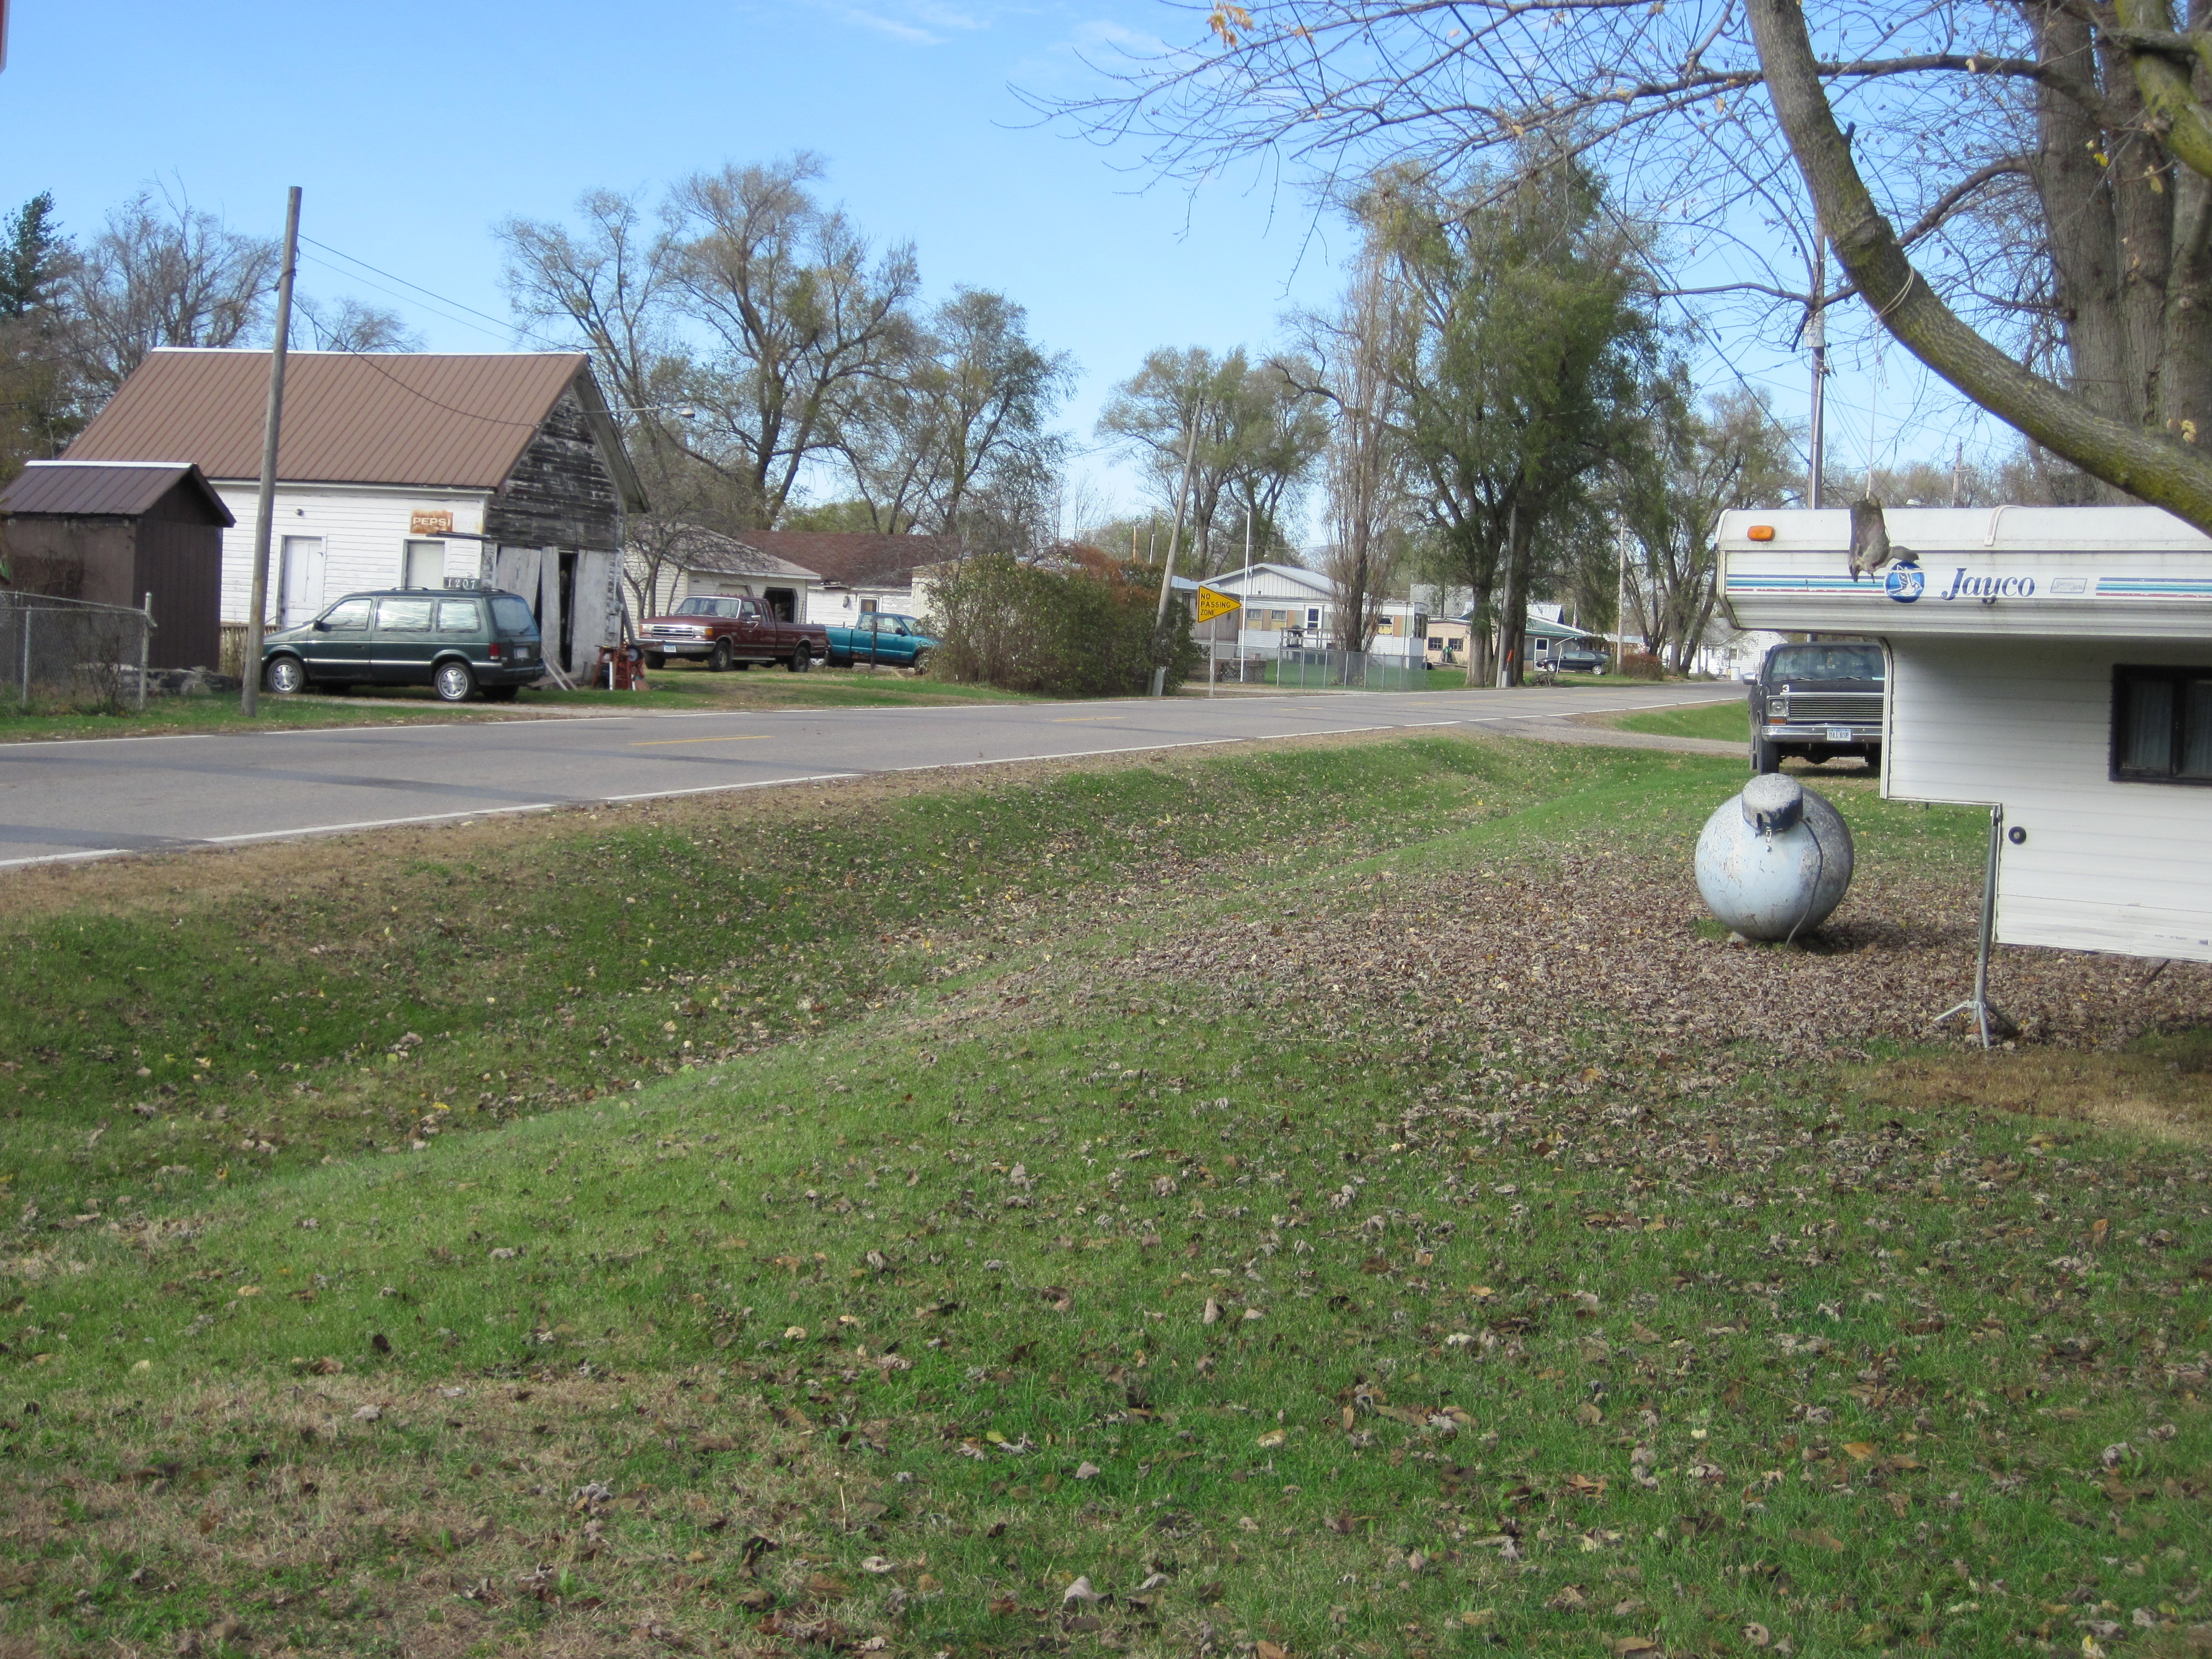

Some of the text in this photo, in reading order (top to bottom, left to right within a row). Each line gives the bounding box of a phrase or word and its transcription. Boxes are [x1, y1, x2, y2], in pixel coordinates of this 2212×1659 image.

[413, 517, 451, 526] PEPSI
[447, 578, 476, 589] 1207
[1940, 567, 2035, 604] Jayco
[1782, 684, 1790, 692] 3
